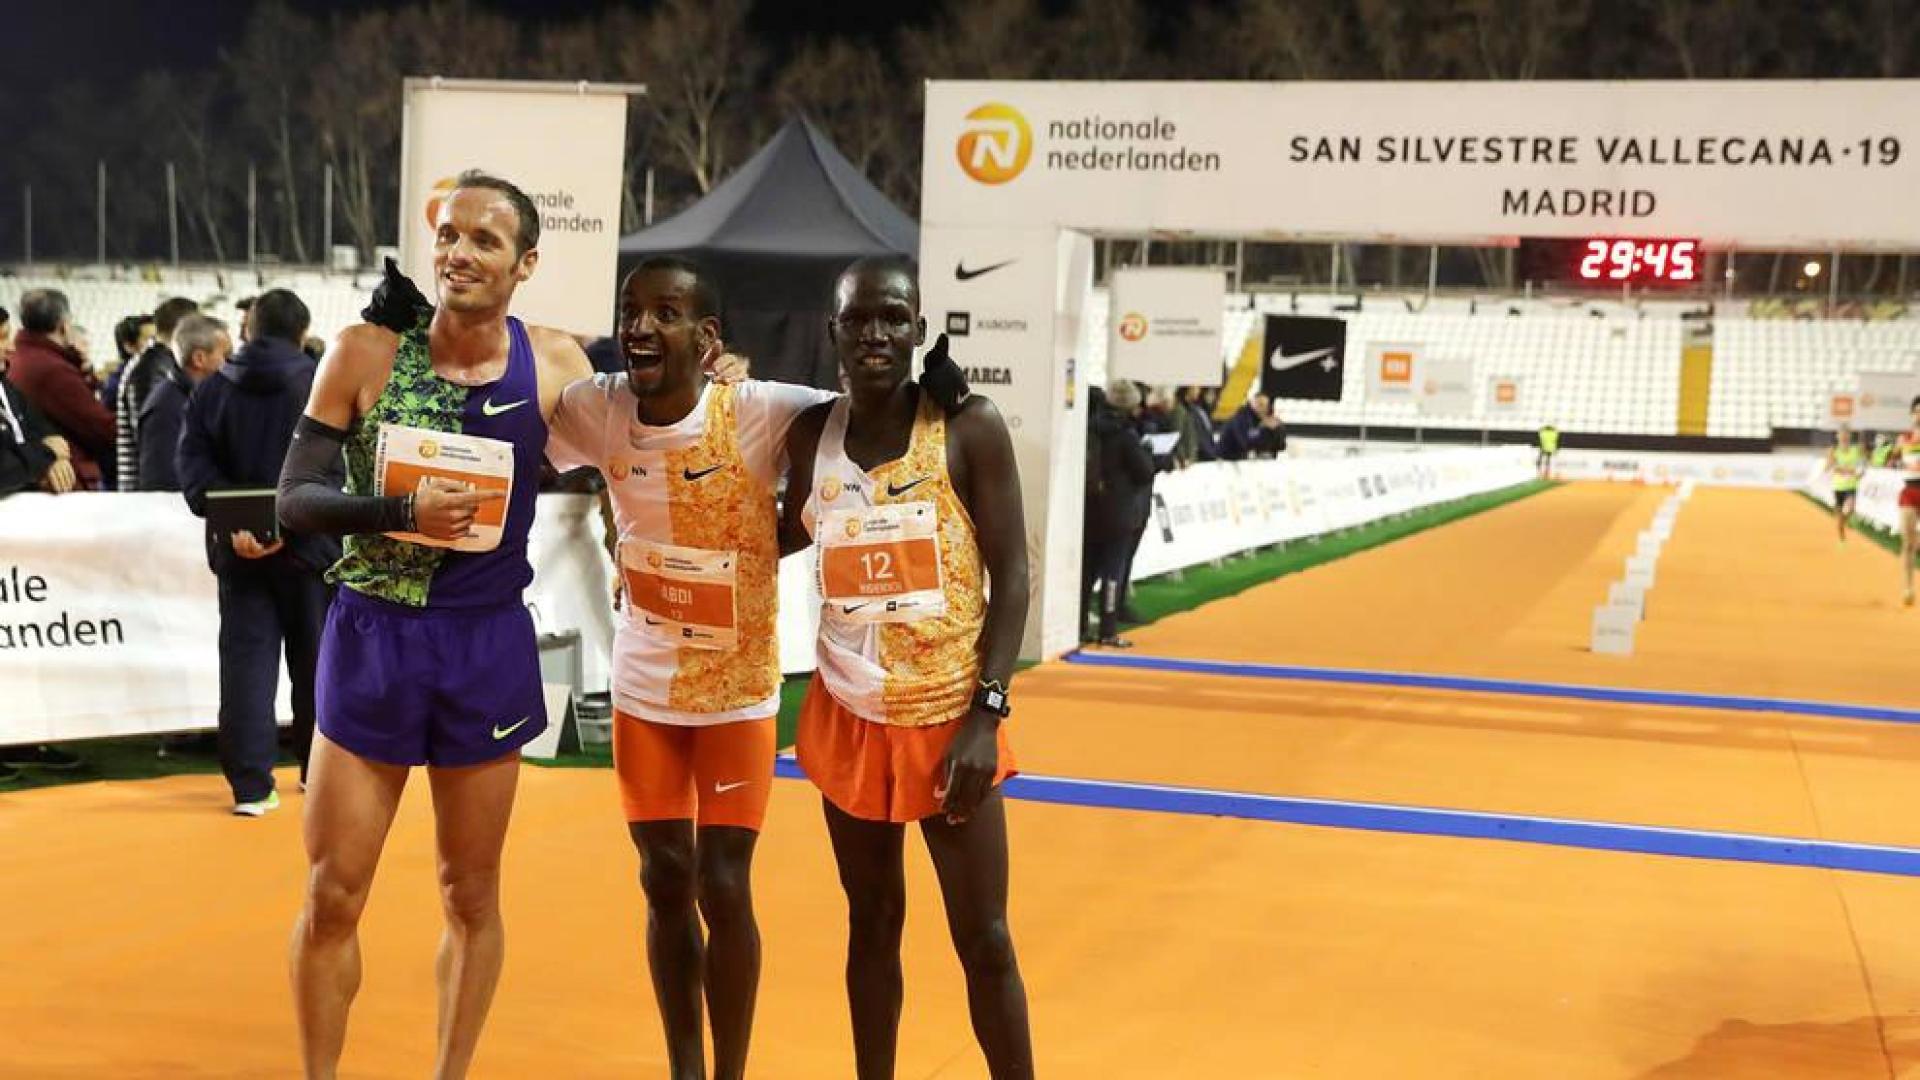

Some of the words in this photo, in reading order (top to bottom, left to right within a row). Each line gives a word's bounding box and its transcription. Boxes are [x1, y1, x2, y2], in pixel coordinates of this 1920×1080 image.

[1049, 116, 1177, 140] nationale
[1048, 147, 1221, 172] nederlanden
[1290, 136, 1362, 162] SAN
[1377, 136, 1579, 163] SILVESTRE
[1502, 188, 1656, 217] MADRID
[1580, 240, 1694, 280] 29:45
[860, 552, 895, 581] 12
